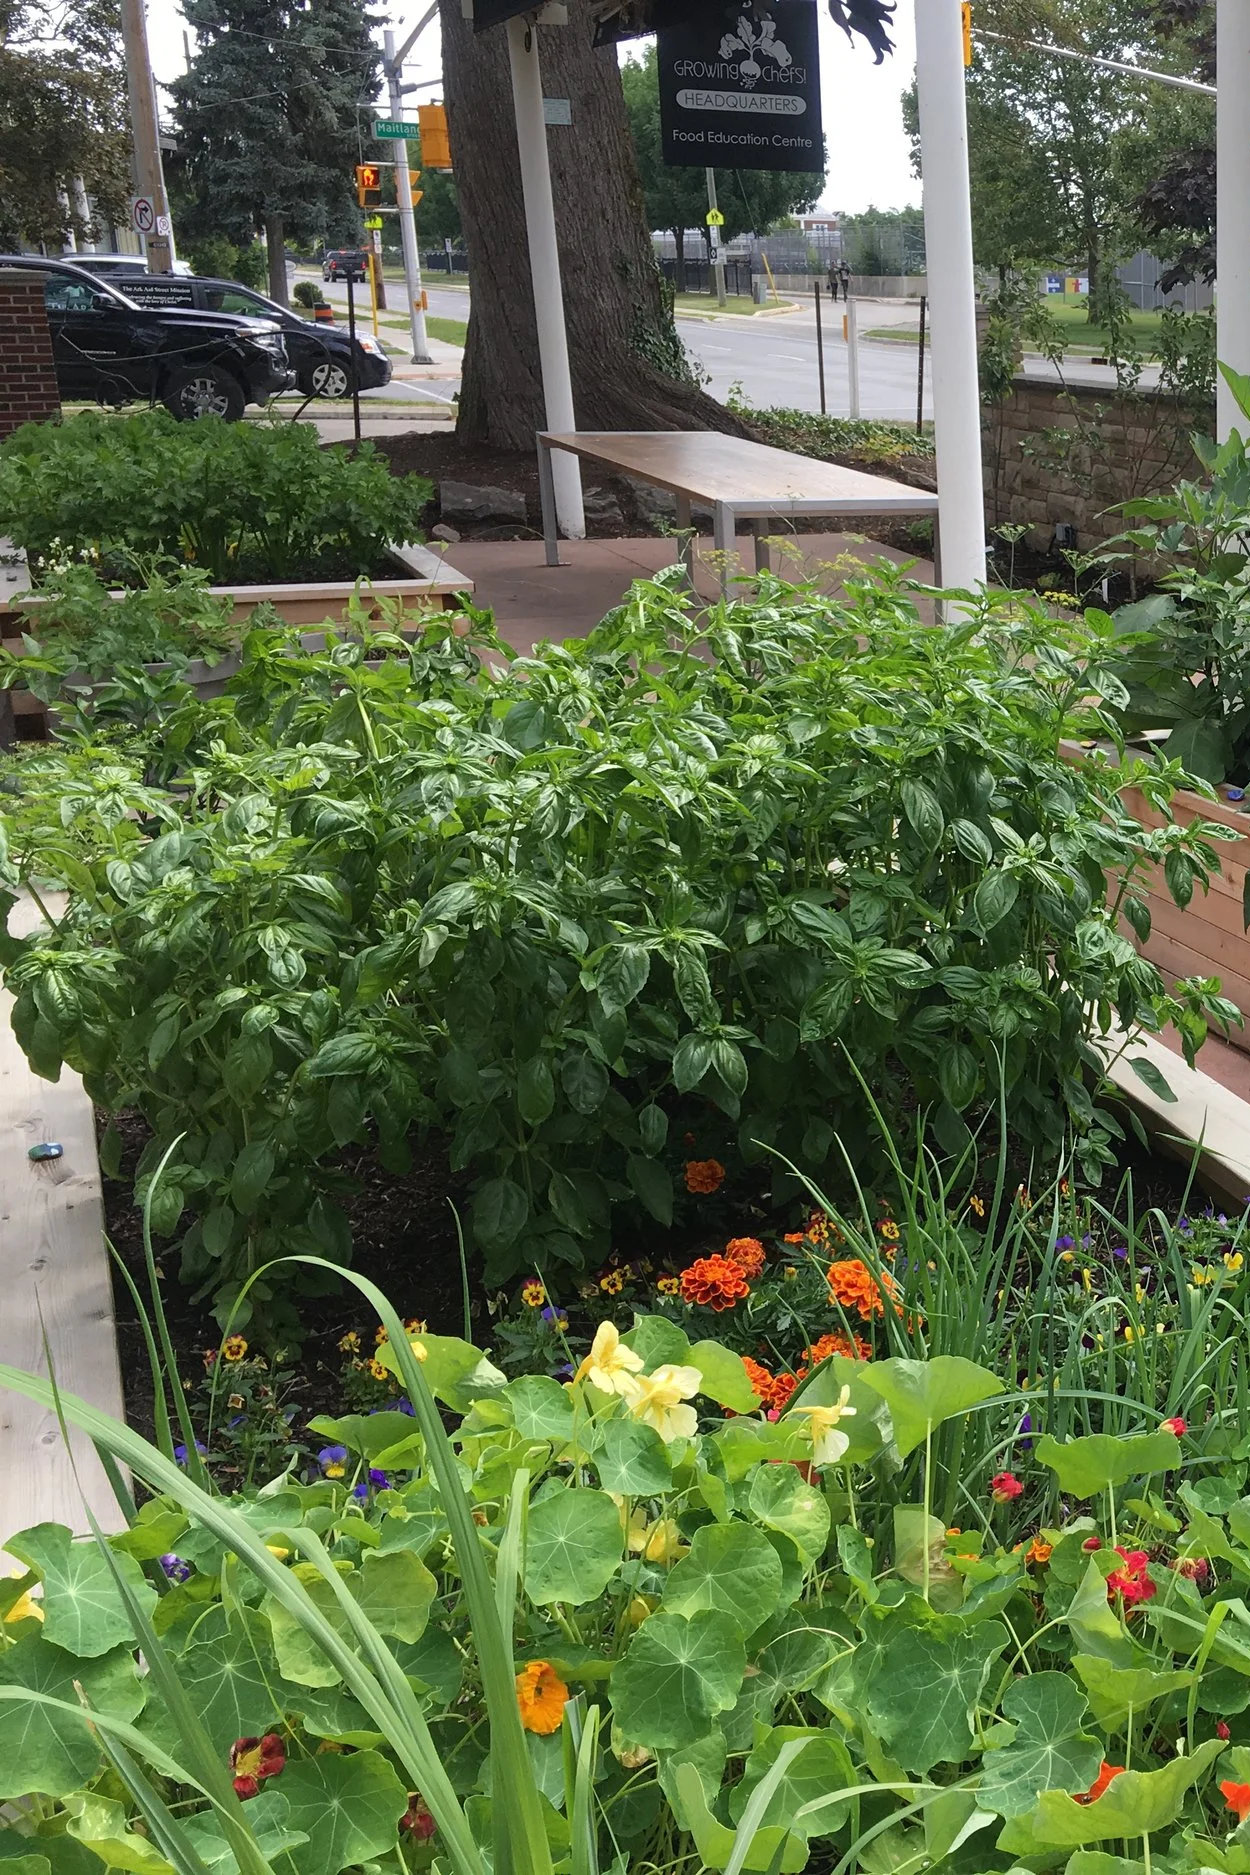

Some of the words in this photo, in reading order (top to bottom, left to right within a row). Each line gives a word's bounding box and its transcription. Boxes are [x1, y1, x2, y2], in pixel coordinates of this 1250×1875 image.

[684, 92, 798, 112] HEADQUARTERS
[673, 129, 704, 142] Food
[707, 131, 769, 146] Education
[772, 135, 813, 148] Centre
